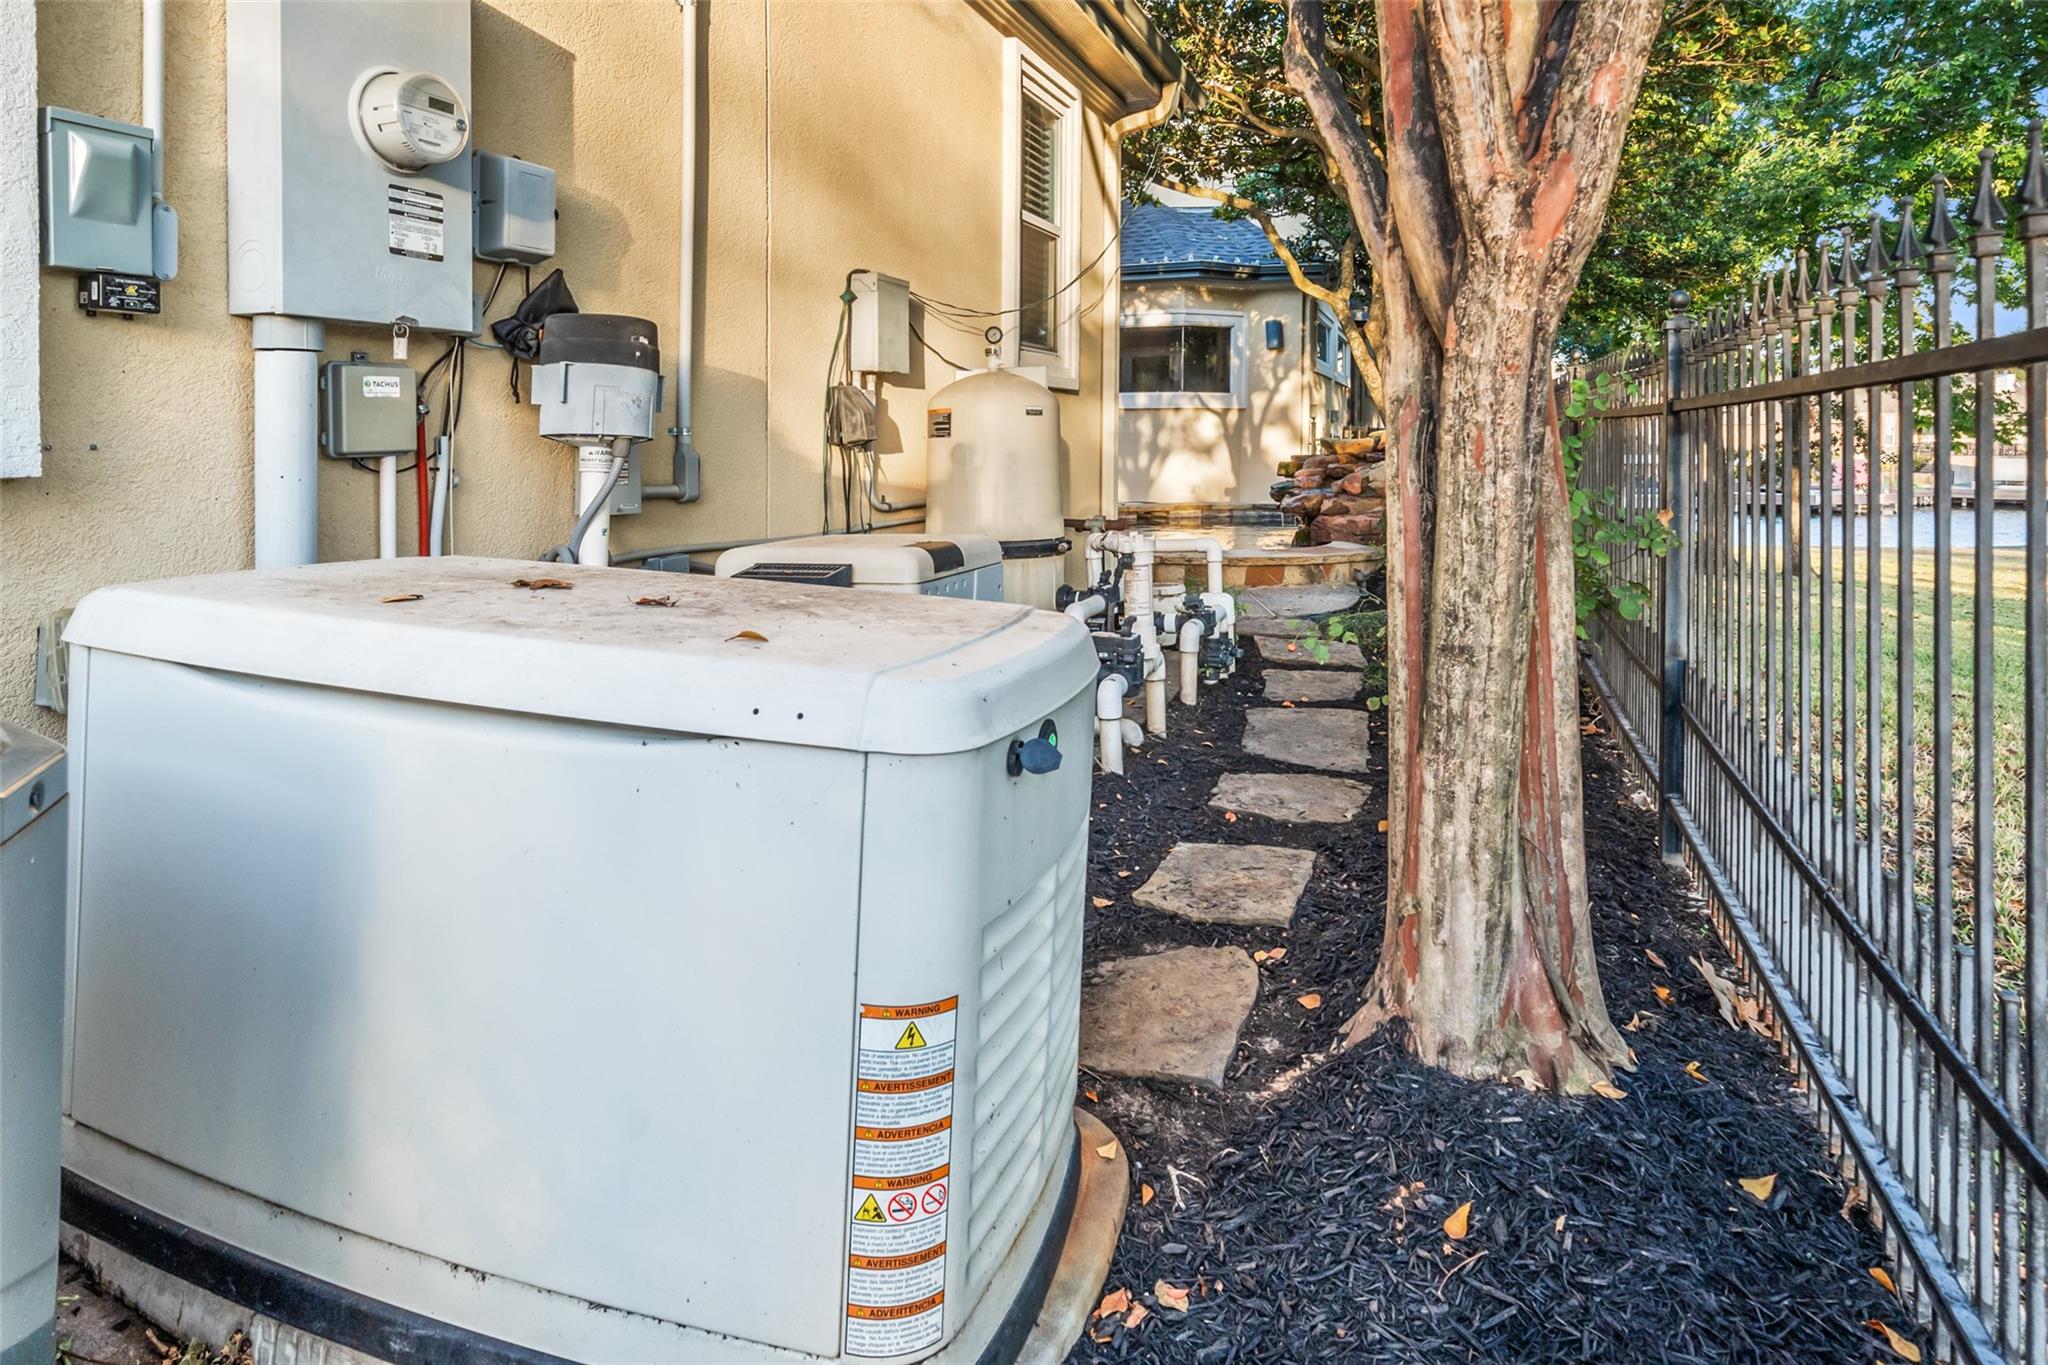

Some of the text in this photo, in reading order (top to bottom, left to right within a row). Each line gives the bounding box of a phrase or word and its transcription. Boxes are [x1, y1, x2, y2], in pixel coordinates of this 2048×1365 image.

[894, 1004, 941, 1017] WARNING
[874, 1071, 952, 1091] AVERTISSEMENT
[877, 1121, 944, 1139] ADVERTENCIA
[887, 1173, 933, 1188] WARNING
[866, 1246, 943, 1268] AVERTISSEMENT
[869, 1298, 936, 1317] ADVERTENCIA
